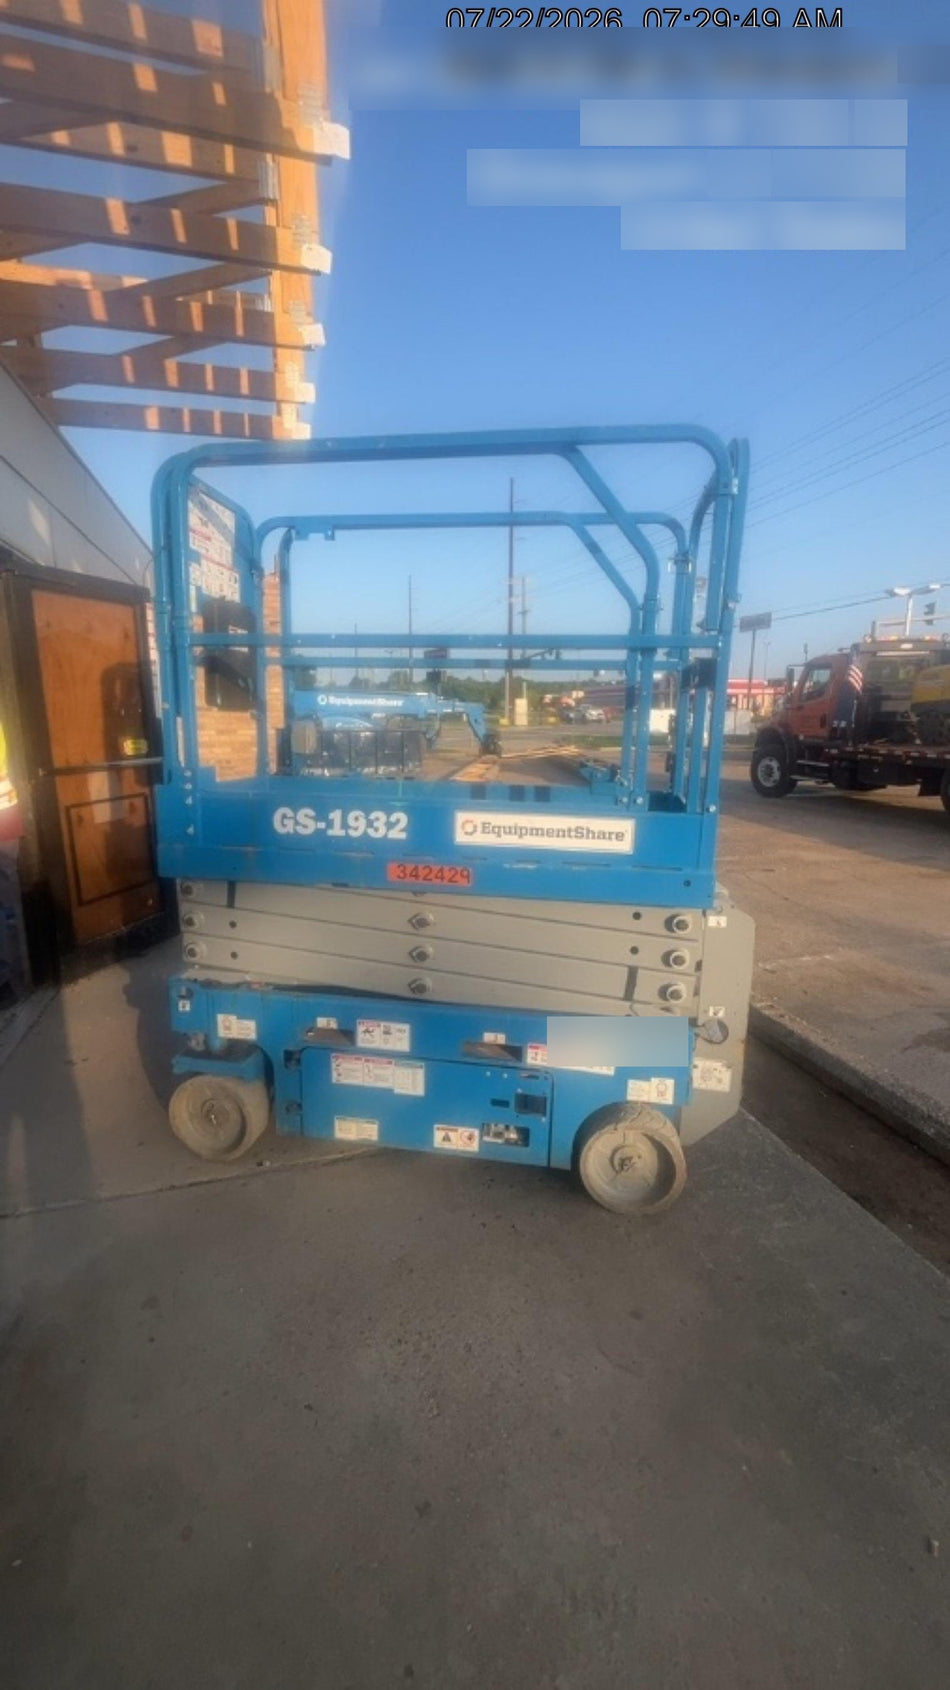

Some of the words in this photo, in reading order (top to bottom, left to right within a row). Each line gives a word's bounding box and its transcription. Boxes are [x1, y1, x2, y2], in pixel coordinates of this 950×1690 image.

[273, 807, 408, 840] GS-1932
[480, 821, 626, 842] EquipmentShare
[396, 864, 471, 884] 342429
